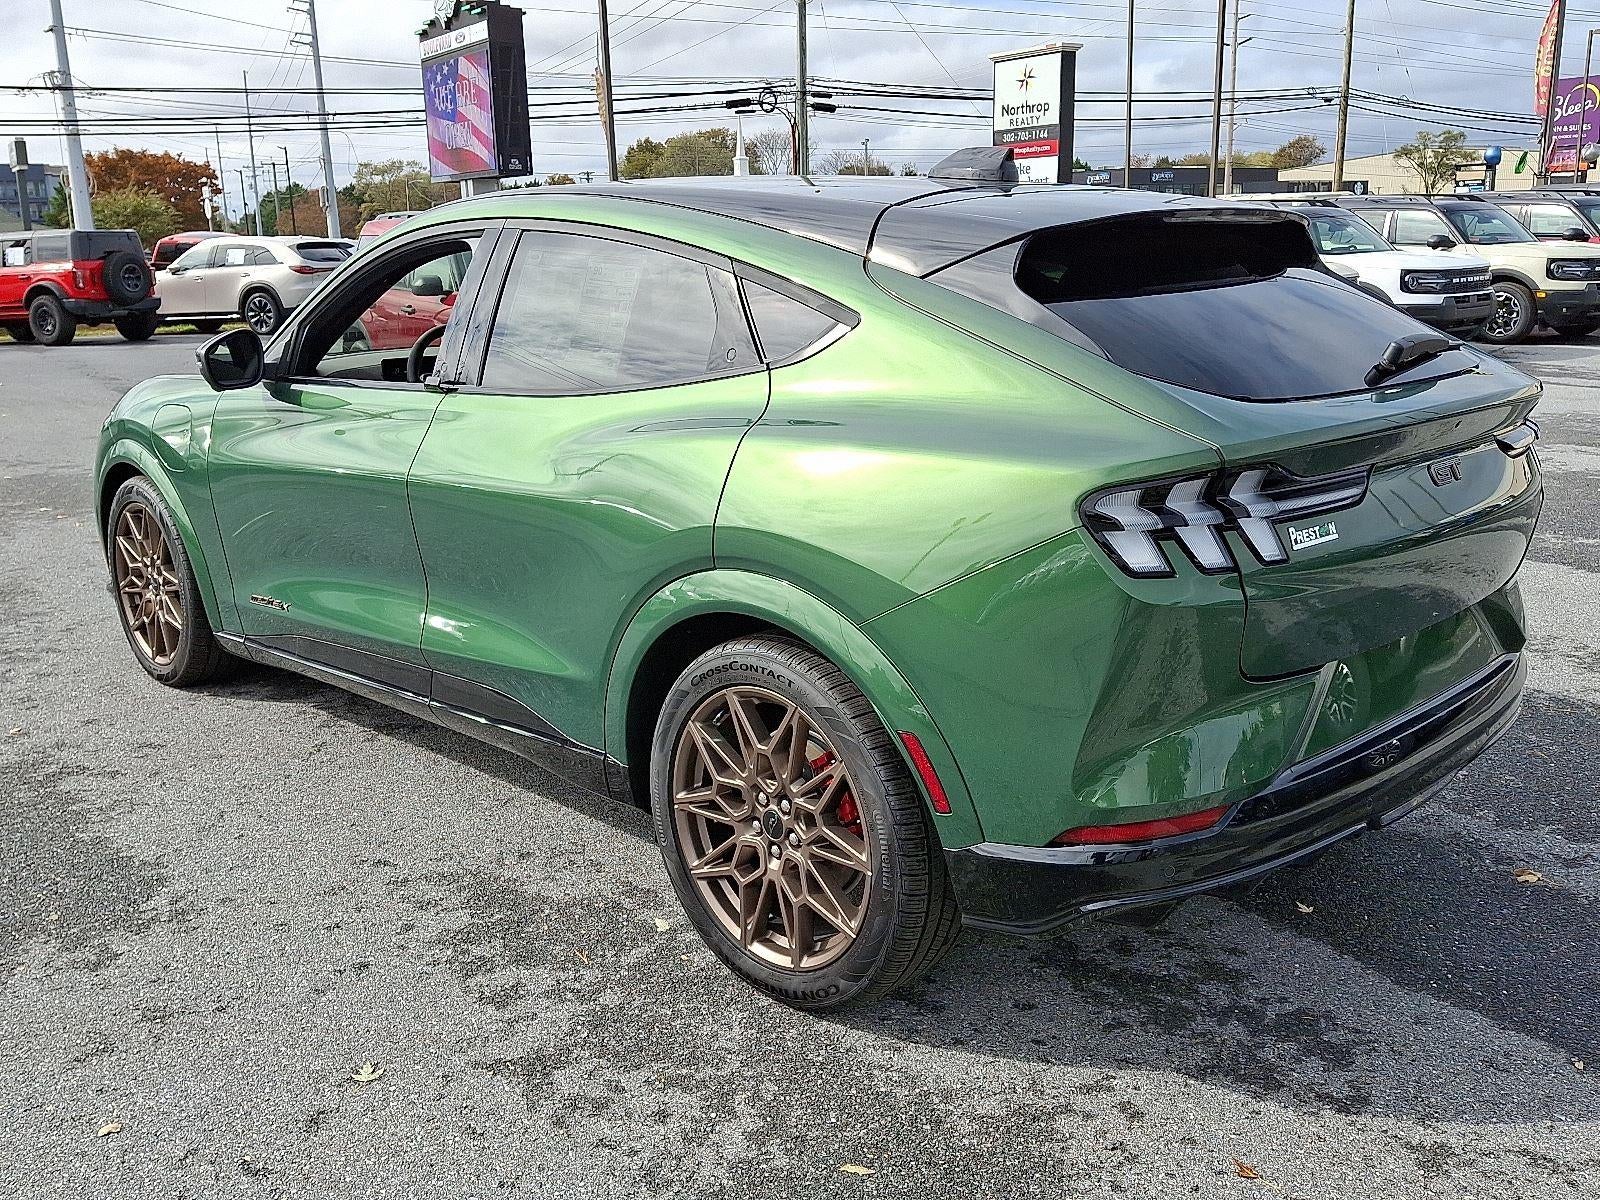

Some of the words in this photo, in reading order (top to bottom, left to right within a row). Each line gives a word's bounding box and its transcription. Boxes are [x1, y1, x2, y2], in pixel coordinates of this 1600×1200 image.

[435, 85, 454, 111] WE
[456, 79, 477, 107] ARE
[1001, 100, 1050, 117] Northrop
[1009, 116, 1041, 127] REALTY
[1427, 458, 1462, 487] GT
